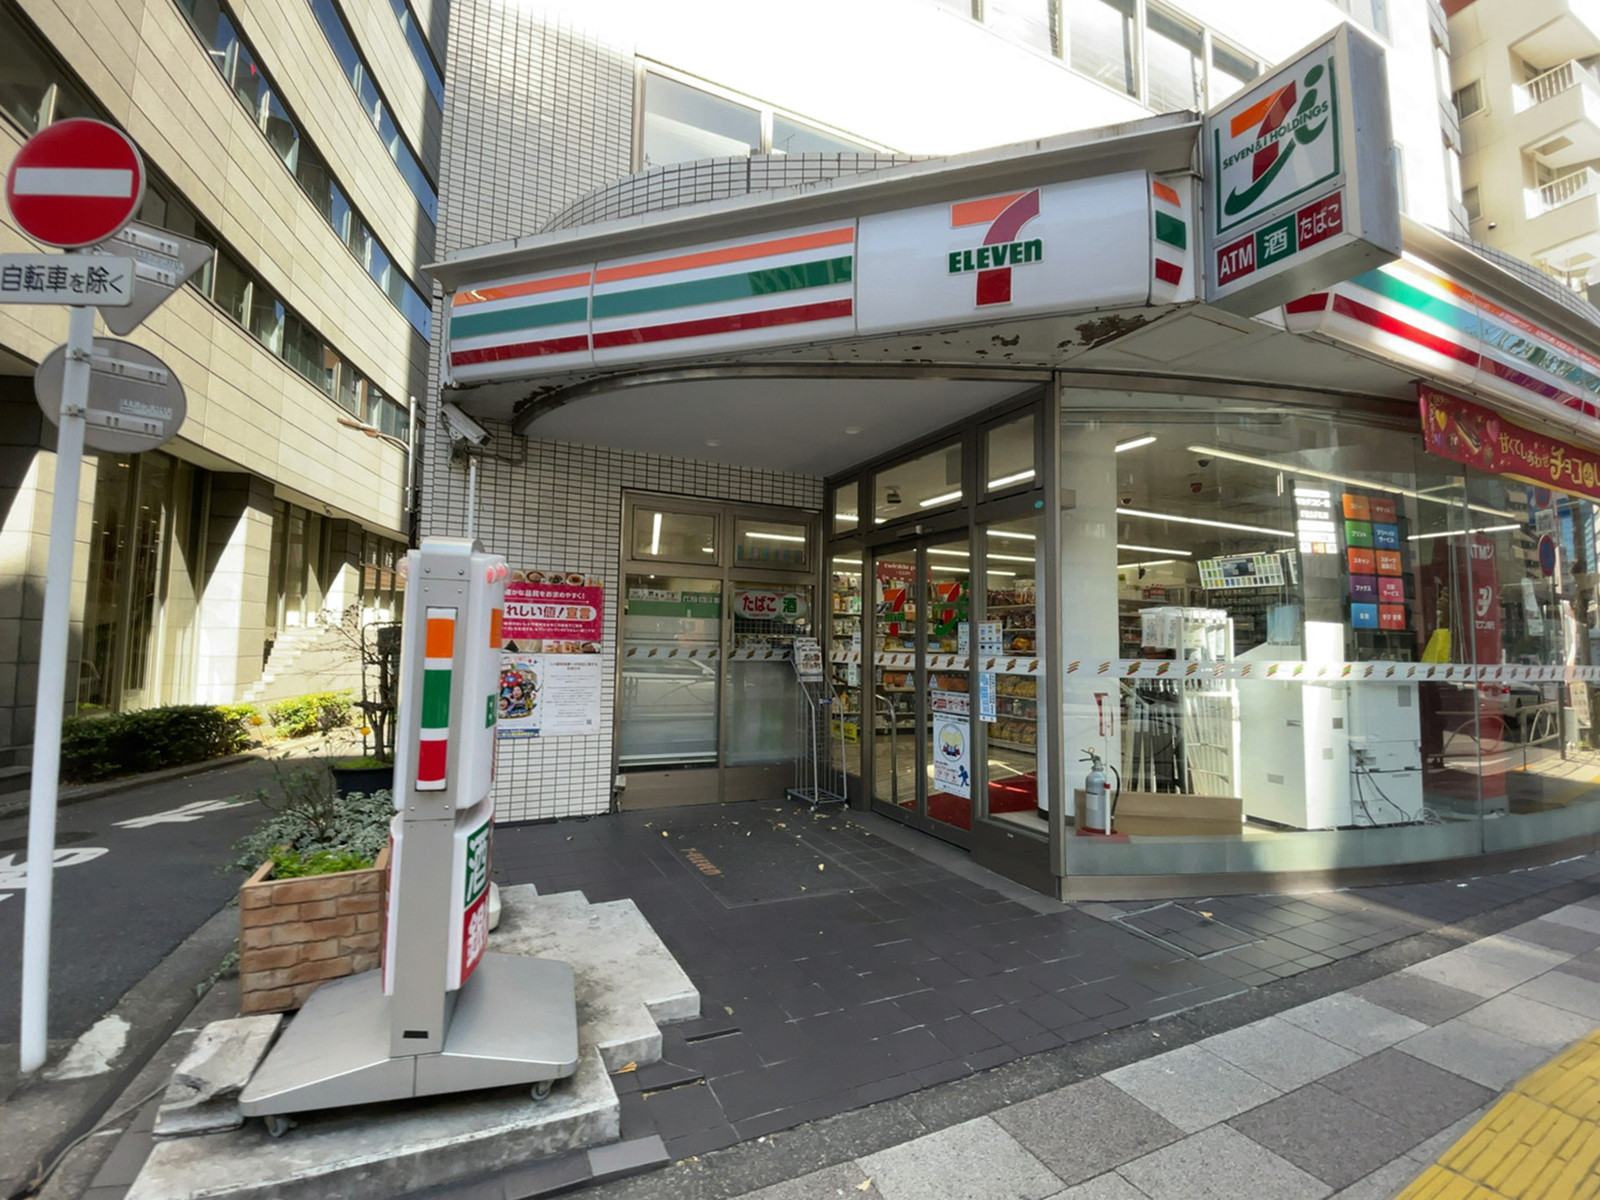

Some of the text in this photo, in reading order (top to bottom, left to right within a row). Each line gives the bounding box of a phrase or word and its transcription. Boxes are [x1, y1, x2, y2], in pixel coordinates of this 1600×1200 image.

[1270, 101, 1329, 142] HOLDINGS
[1220, 204, 1341, 279] ATM 酒 たばこ
[1, 264, 124, 295] 自転車を除く
[743, 595, 797, 613] たばこ 酒
[467, 826, 489, 902] 酒
